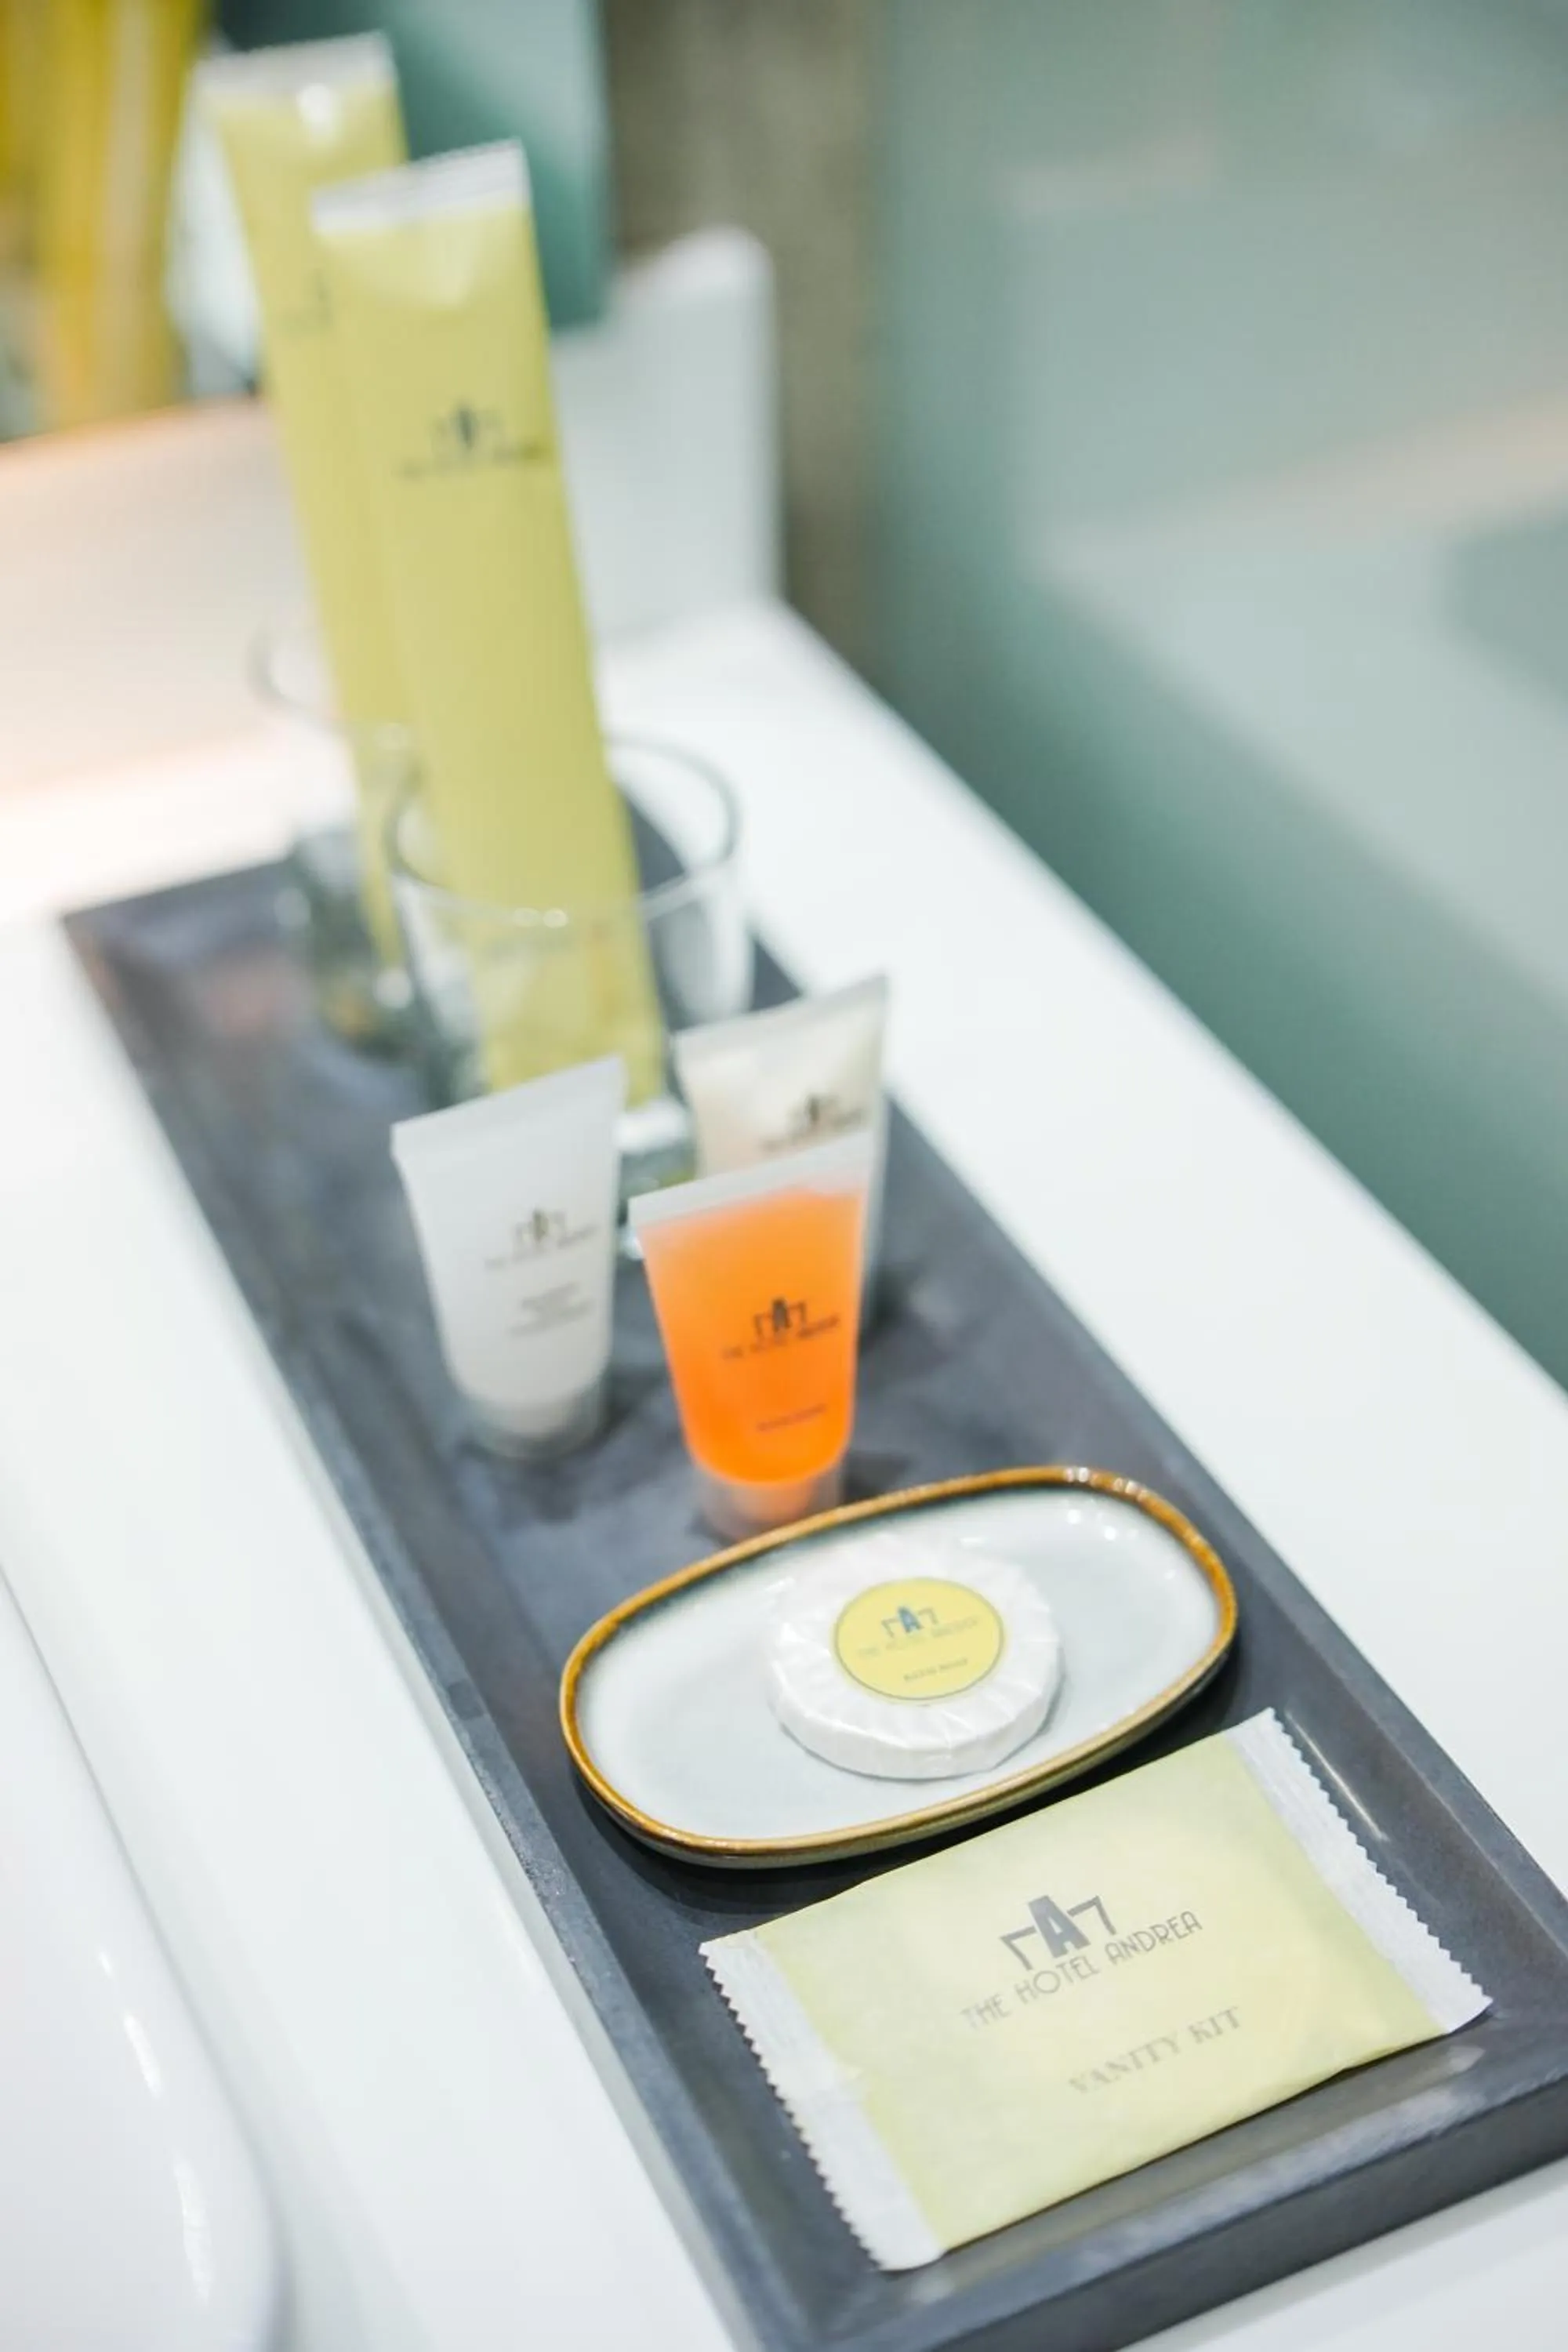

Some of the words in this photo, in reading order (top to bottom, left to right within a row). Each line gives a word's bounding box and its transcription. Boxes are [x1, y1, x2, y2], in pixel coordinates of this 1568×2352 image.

[960, 1991, 1012, 2031] THE
[1014, 1955, 1100, 2005] HOTEL
[1105, 1911, 1203, 1965] ANDREA
[1069, 2032, 1181, 2094] VANITY
[1189, 2005, 1241, 2044] KIT
